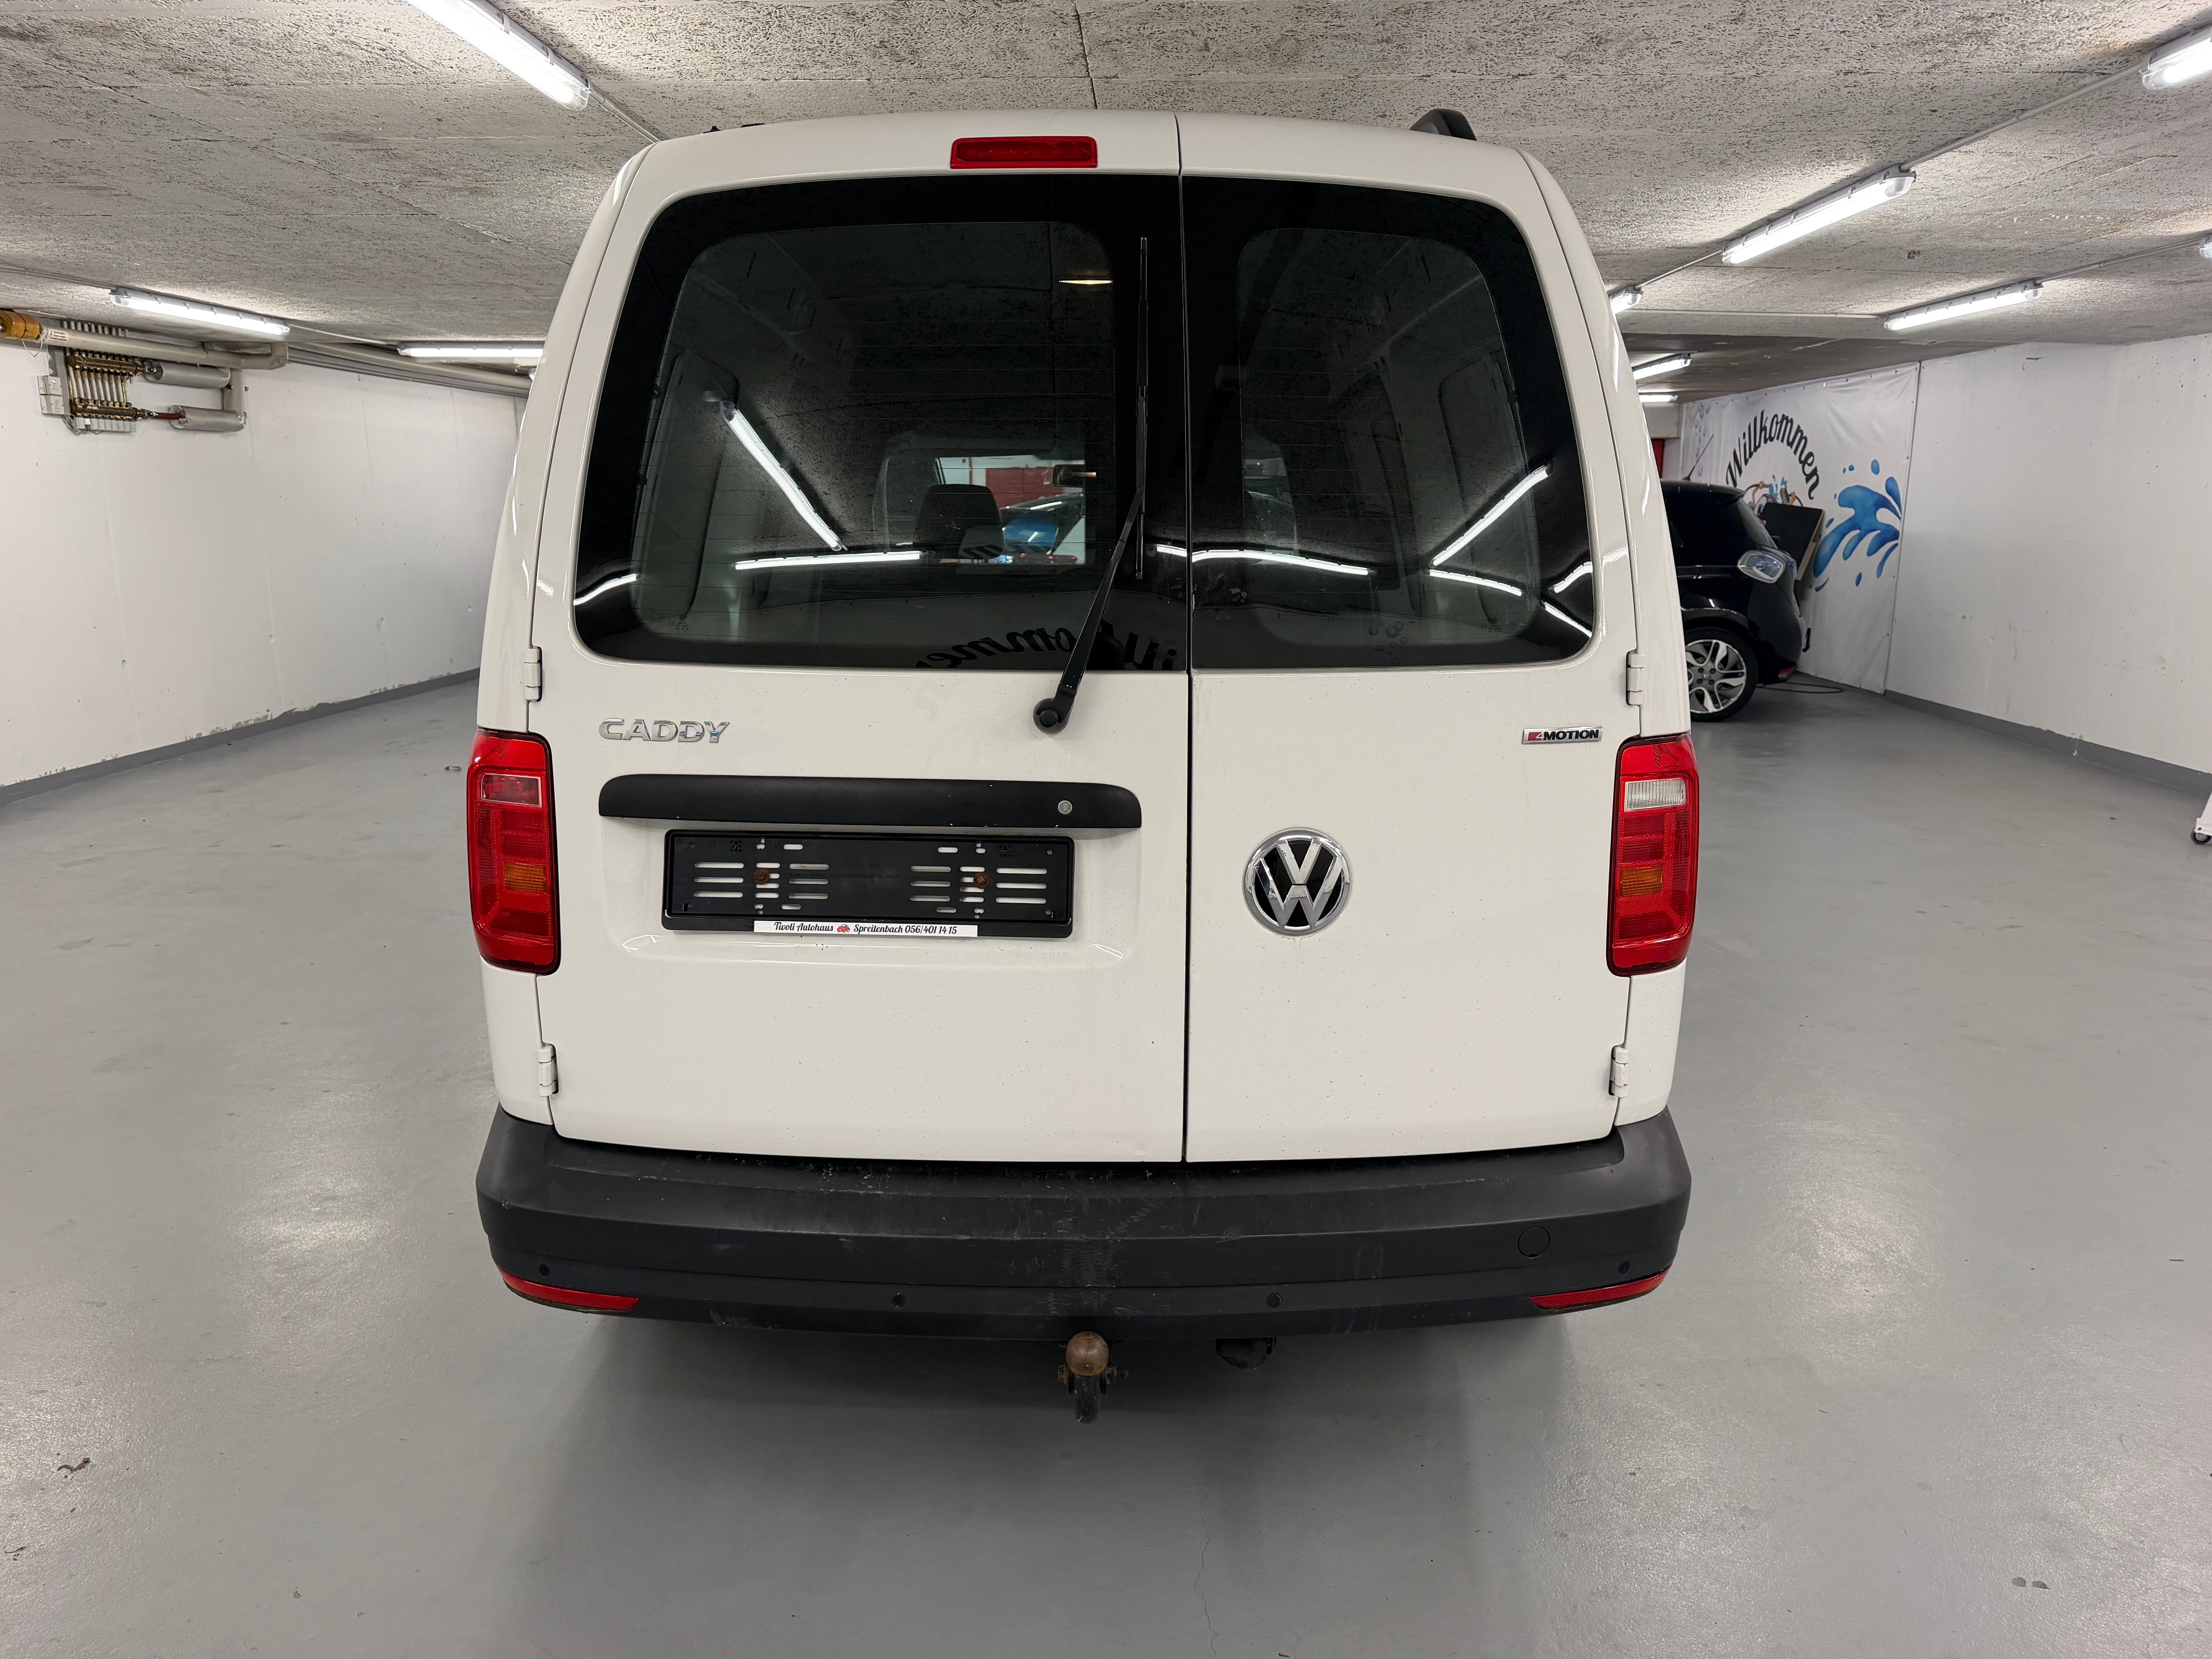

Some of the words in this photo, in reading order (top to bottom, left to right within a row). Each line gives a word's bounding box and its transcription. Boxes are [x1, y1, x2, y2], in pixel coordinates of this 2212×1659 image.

[1726, 409, 1819, 500] Willkommen
[598, 718, 730, 744] CADDY
[1535, 729, 1599, 740] 4MOTION
[1248, 833, 1348, 931] VW
[774, 922, 795, 931] Tivoli
[797, 923, 833, 932] Autohaus
[854, 924, 903, 934] Spreitenbach
[905, 925, 937, 934] 056/401
[939, 926, 947, 934] 14
[949, 926, 957, 934] 15
